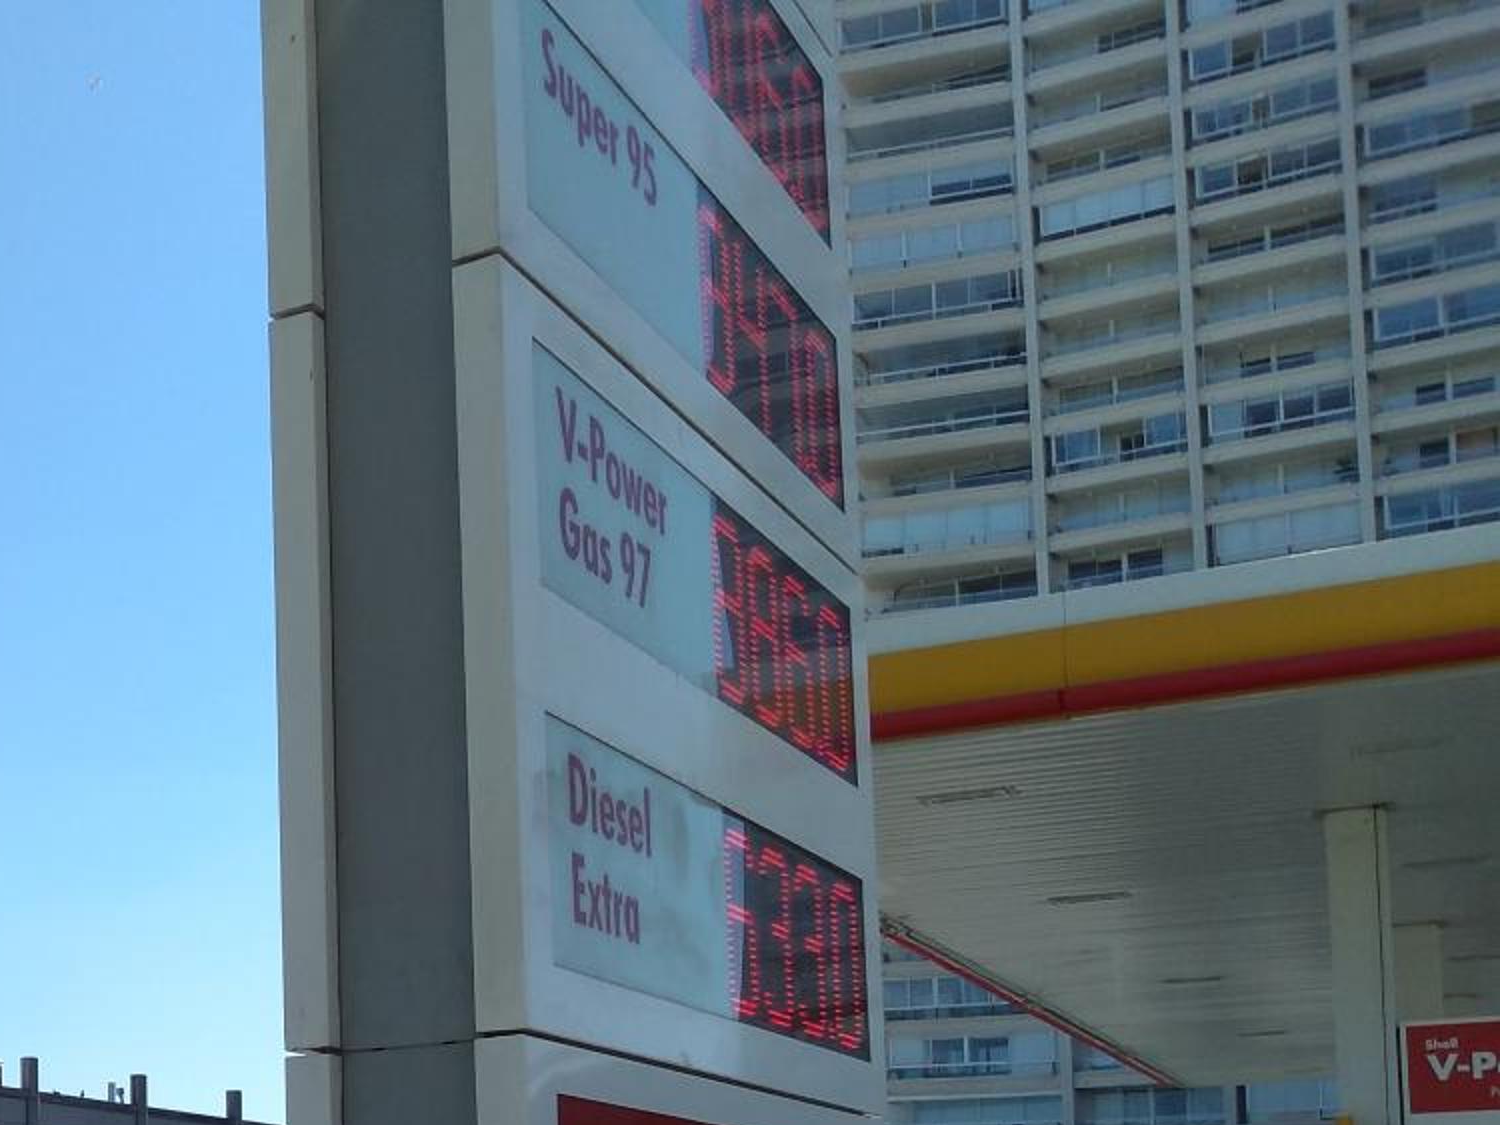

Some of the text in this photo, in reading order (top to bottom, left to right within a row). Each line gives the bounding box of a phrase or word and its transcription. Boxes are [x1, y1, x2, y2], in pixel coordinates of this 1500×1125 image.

[541, 27, 657, 207] Super 95
[555, 385, 668, 536] V-Power
[559, 487, 651, 609] Gas 97
[567, 752, 653, 858] Diesel
[571, 852, 641, 945] Extra
[1424, 1036, 1460, 1051] Shell
[1425, 1050, 1500, 1082] V-P
